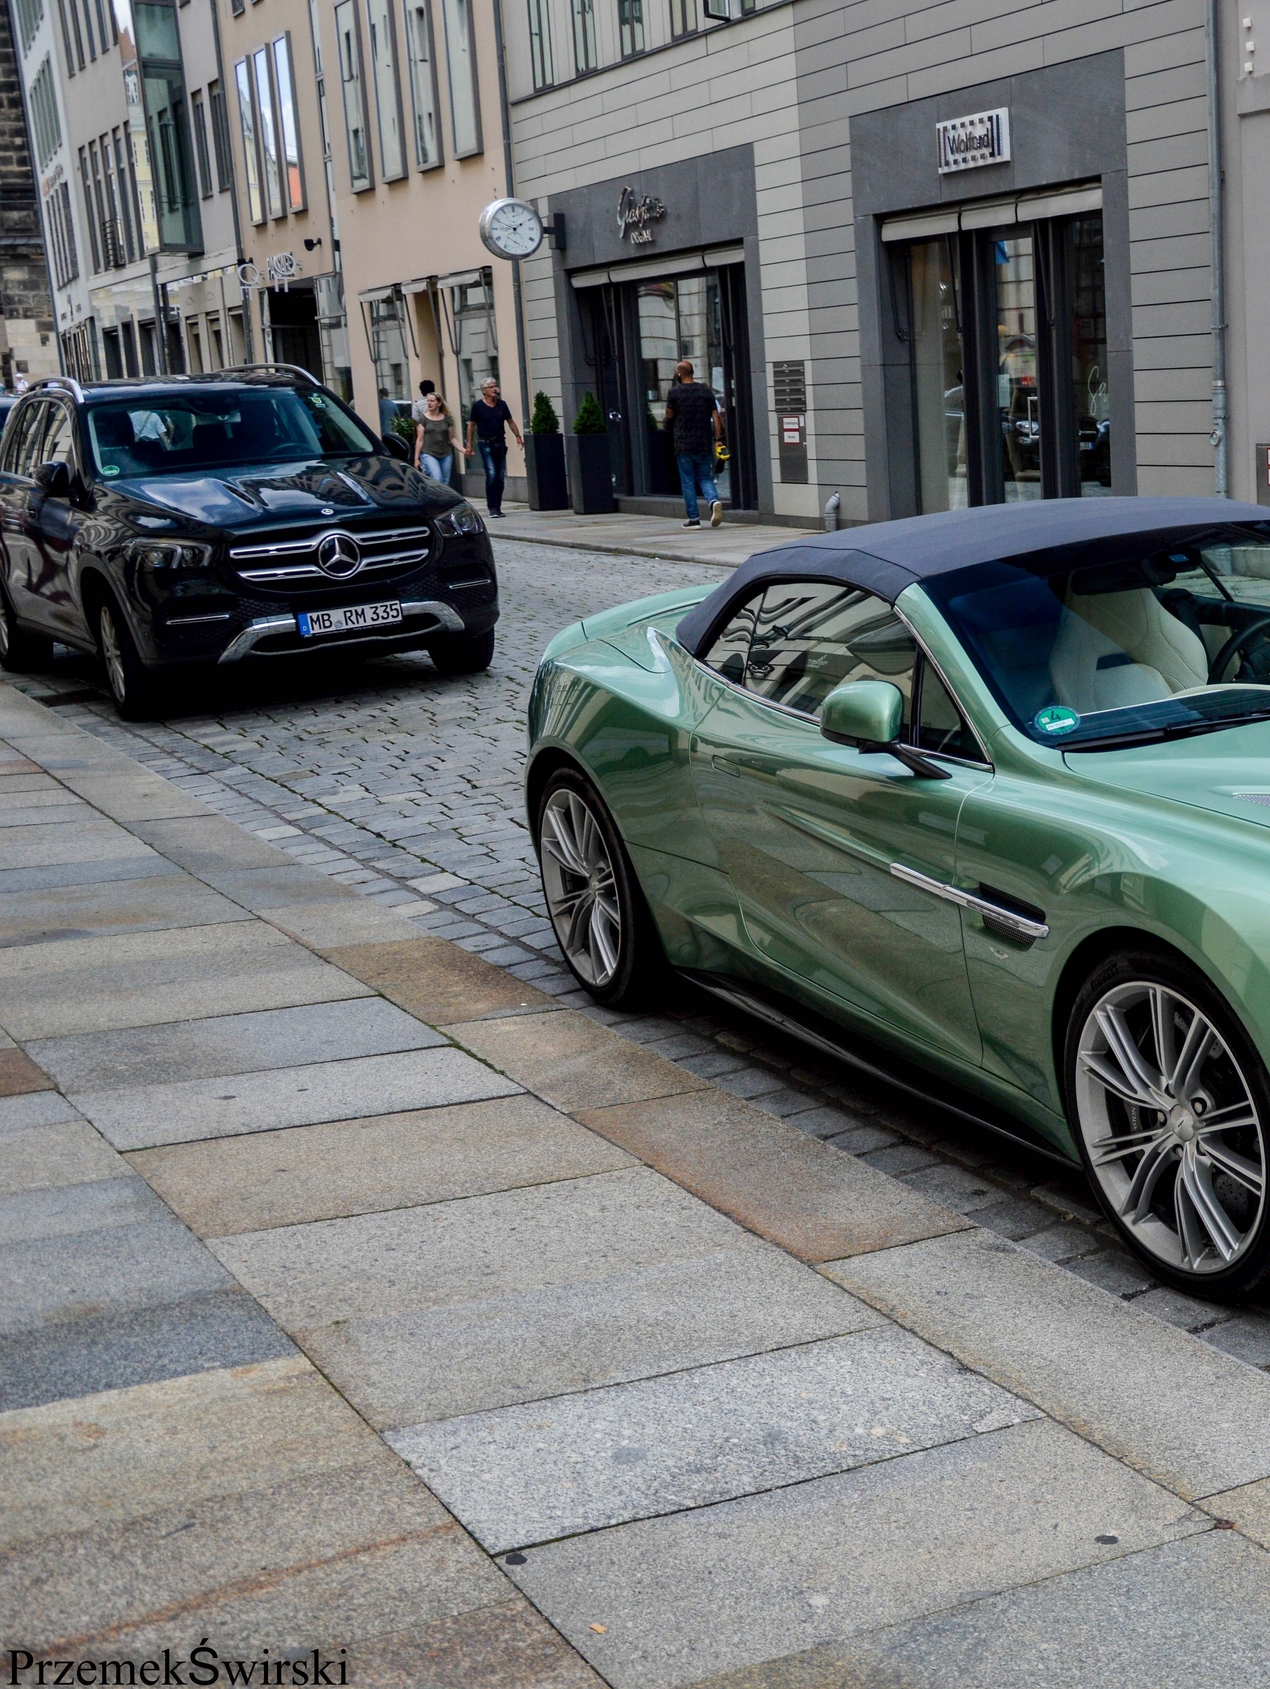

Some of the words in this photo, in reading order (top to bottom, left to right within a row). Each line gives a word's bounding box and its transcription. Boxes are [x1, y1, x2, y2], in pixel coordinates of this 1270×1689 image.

[947, 126, 990, 155] Wolford
[309, 613, 333, 631] MB
[343, 608, 367, 626] RM
[370, 603, 400, 622] 335
[1050, 710, 1061, 721] 4
